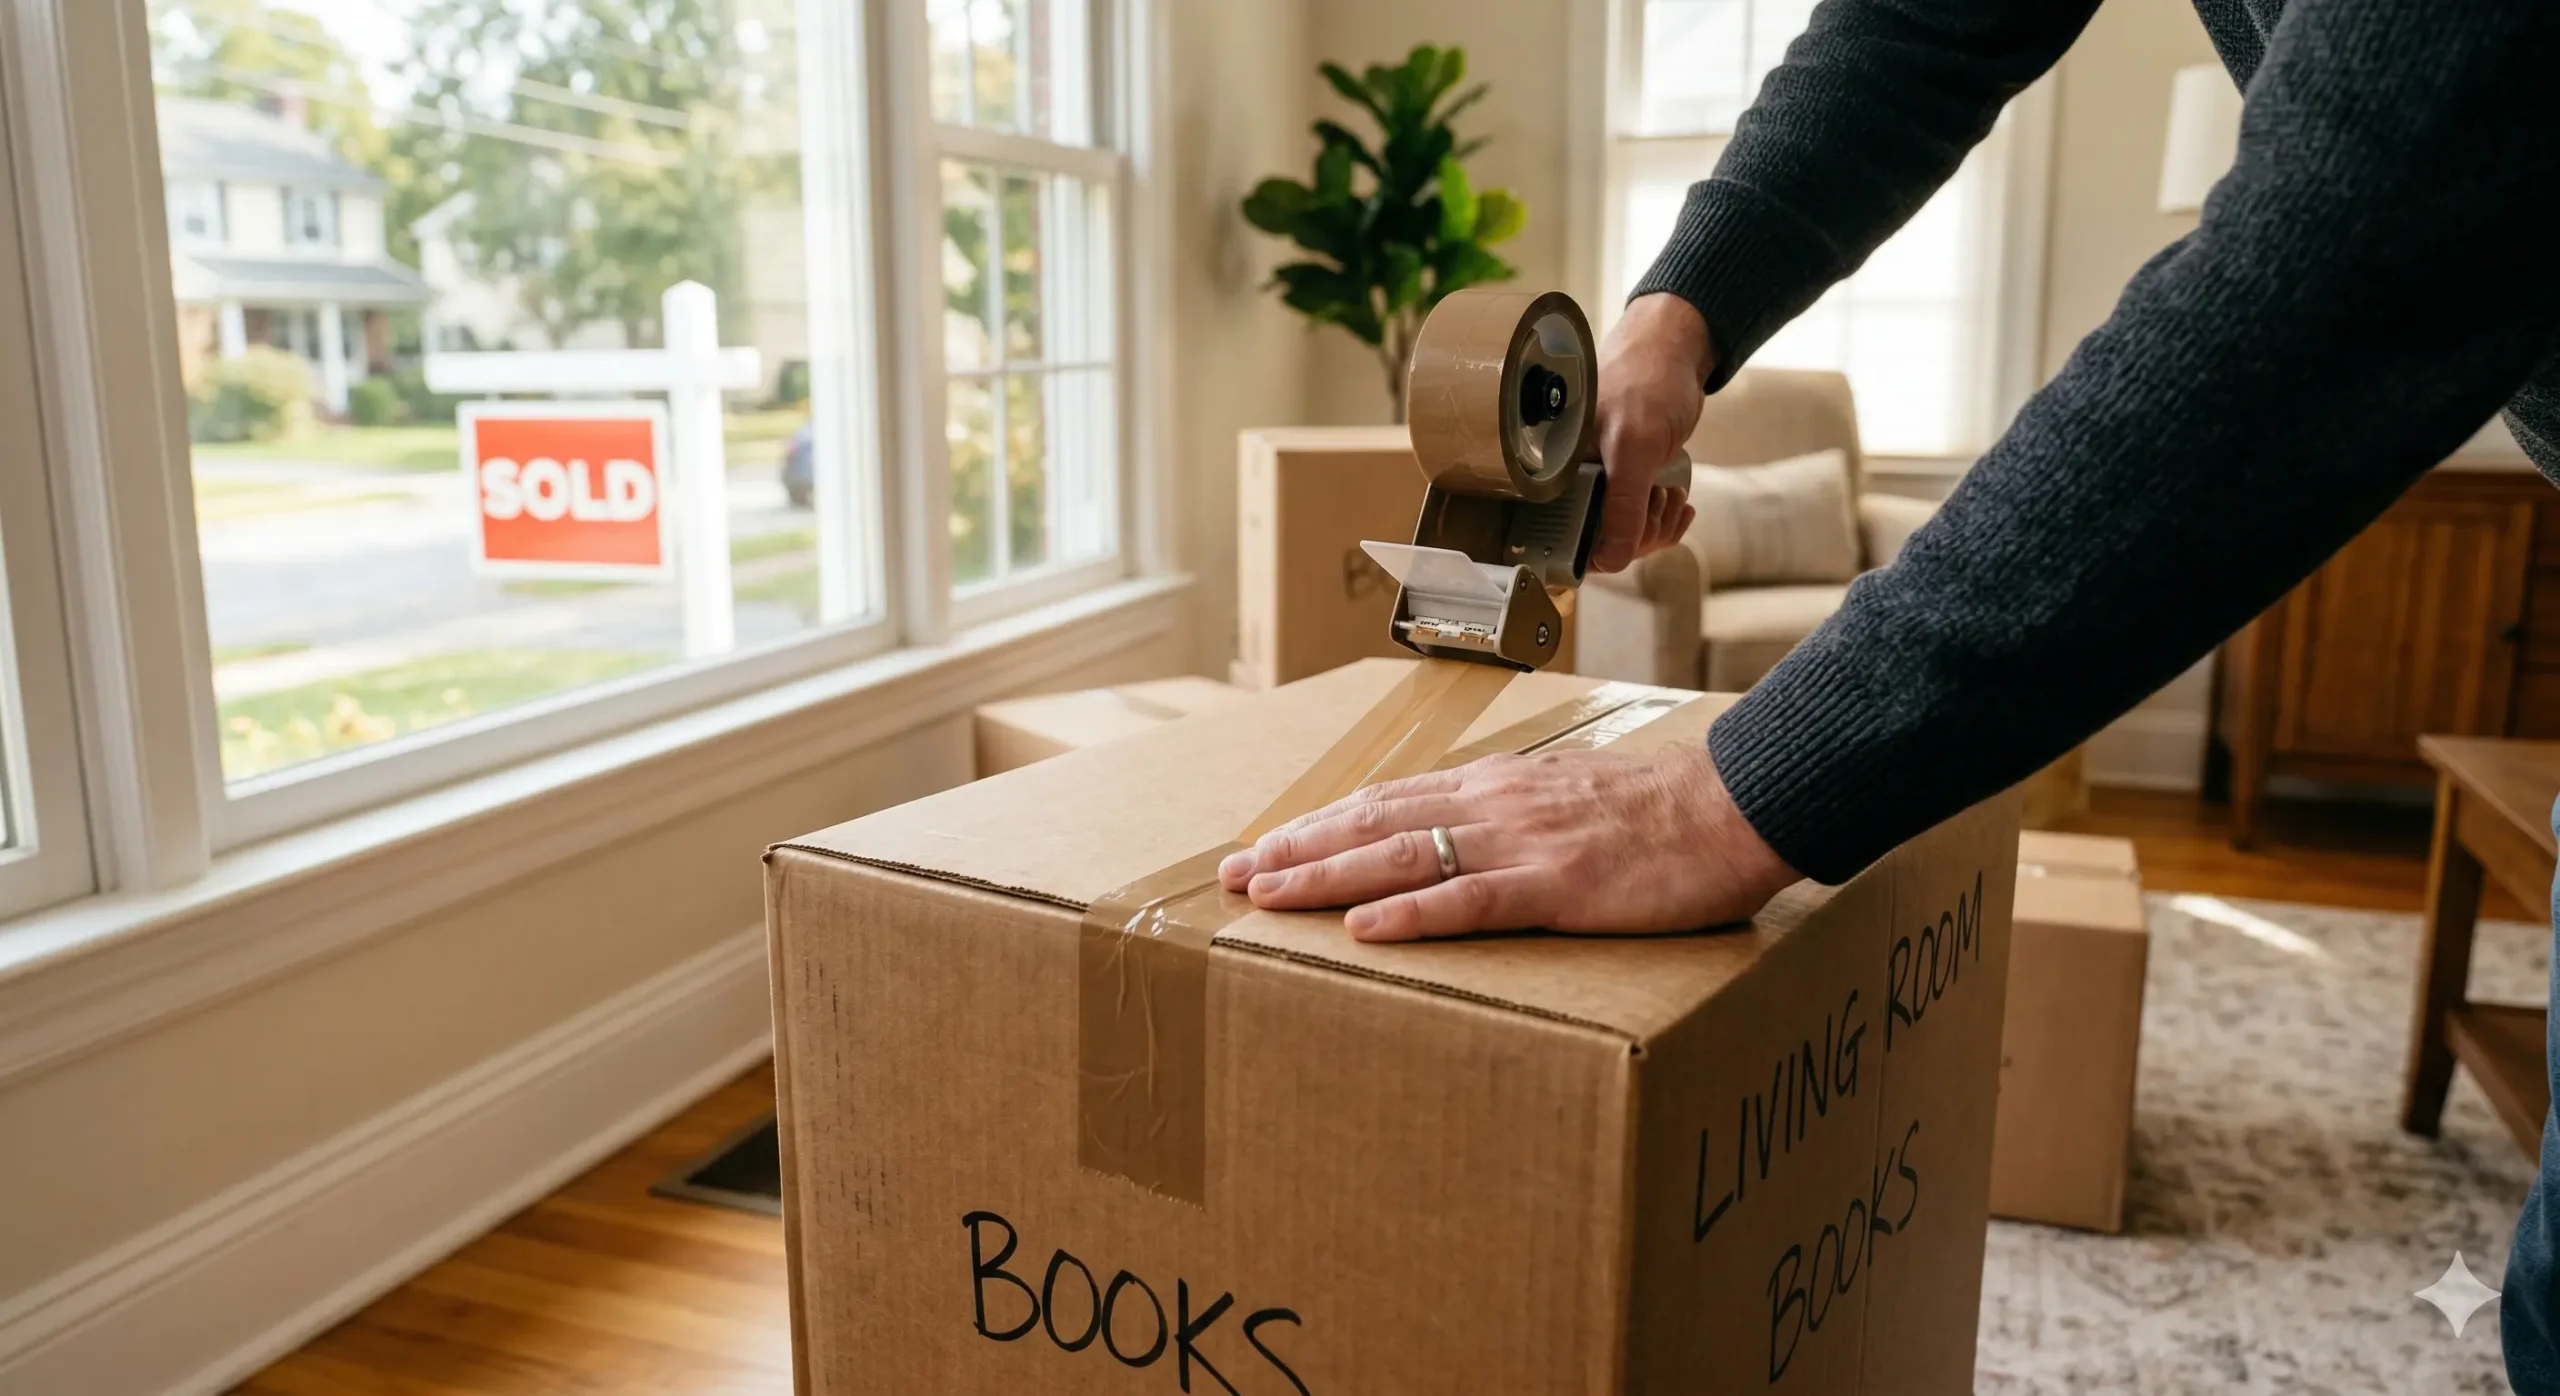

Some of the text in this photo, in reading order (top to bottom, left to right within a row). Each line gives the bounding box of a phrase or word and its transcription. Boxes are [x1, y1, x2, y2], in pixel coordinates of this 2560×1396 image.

[481, 457, 656, 522] SOLD
[1692, 870, 1983, 1245] LIVING ROOM
[1765, 1119, 1920, 1386] BOOKS
